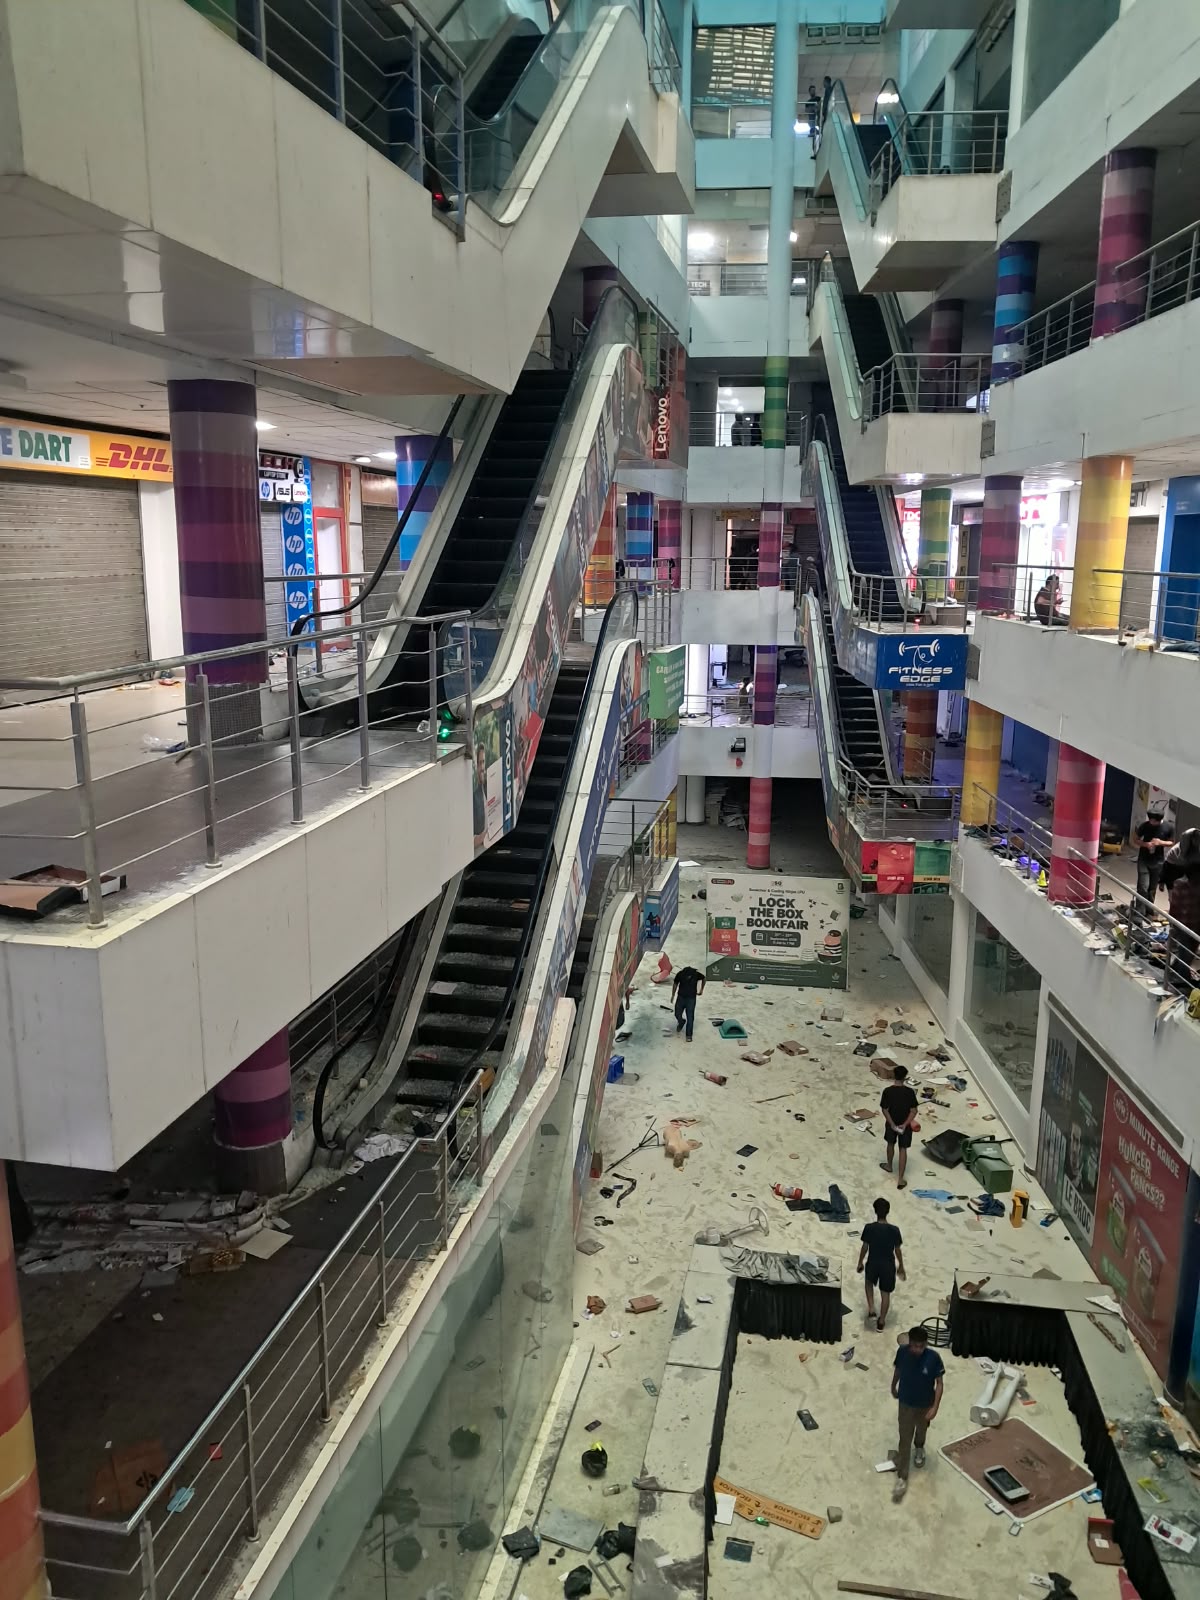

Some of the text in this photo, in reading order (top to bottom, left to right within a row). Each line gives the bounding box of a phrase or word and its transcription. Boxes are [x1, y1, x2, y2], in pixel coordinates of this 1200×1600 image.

[655, 397, 668, 452] Lenovo
[18, 430, 73, 463] DART
[109, 442, 170, 472] DHL
[277, 487, 290, 496] ASUS
[287, 506, 301, 525] hp
[288, 535, 303, 553] hp
[291, 591, 306, 609] hp
[899, 675, 941, 683] EDGE
[758, 897, 796, 908] LOCK
[749, 907, 804, 919] THE BOX
[746, 917, 809, 931] BOOKFAIR
[1129, 1112, 1180, 1179] MINUTE RANGE
[1118, 1136, 1152, 1180] HUNGER
[1065, 1185, 1092, 1233] LE BROC
[719, 1481, 752, 1503] ESCALATOR
[774, 1504, 811, 1521] ESCALATOR
